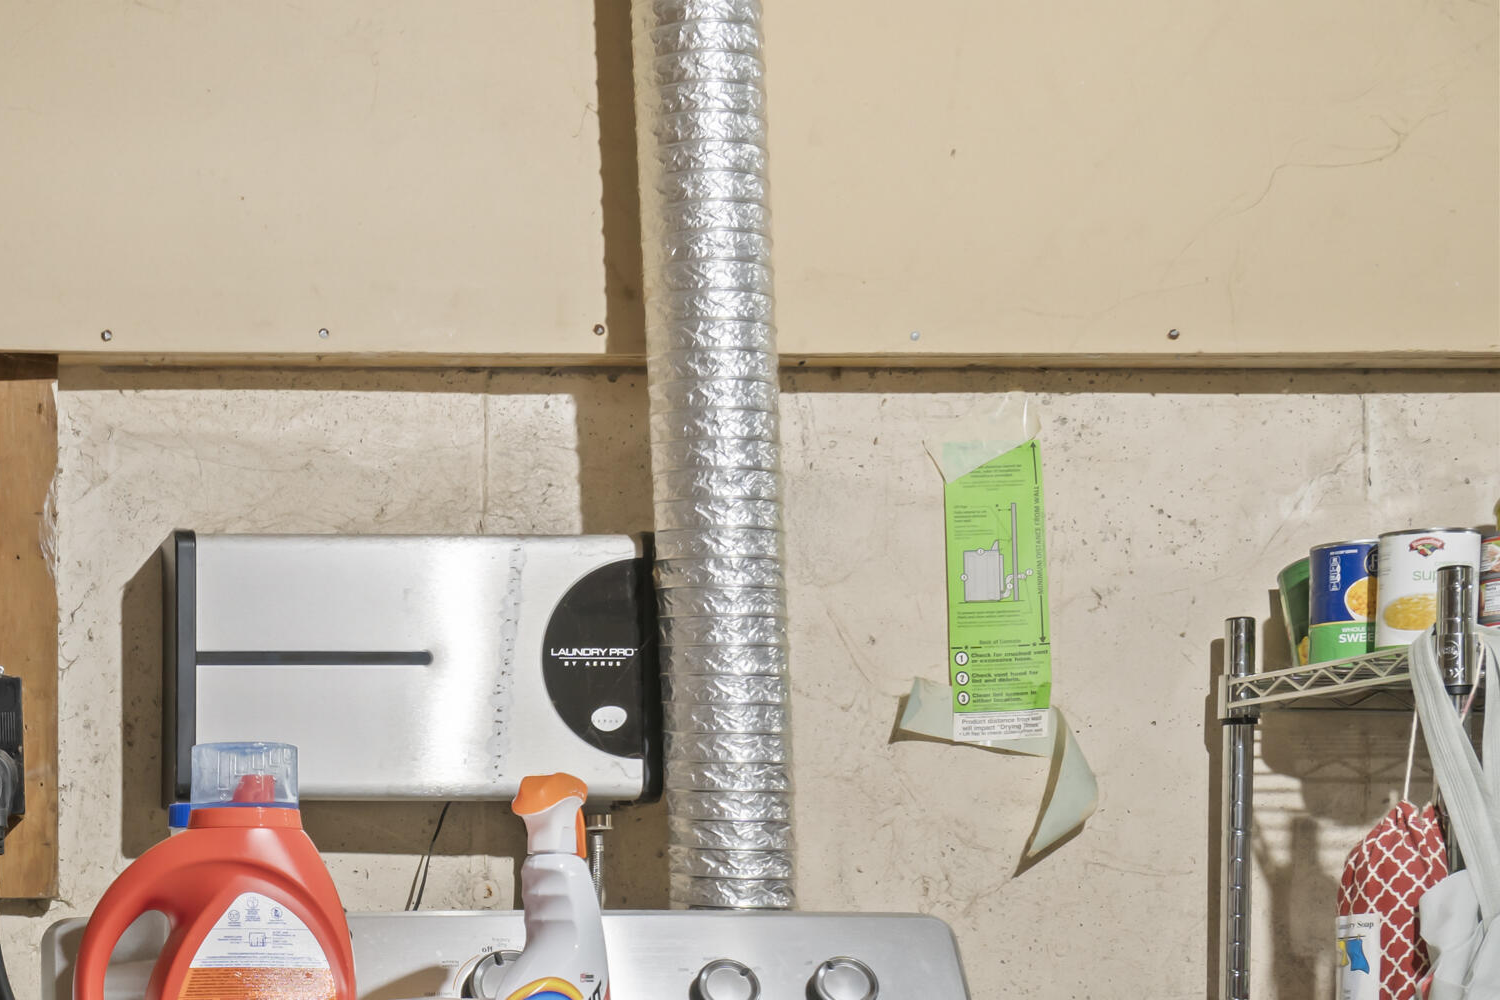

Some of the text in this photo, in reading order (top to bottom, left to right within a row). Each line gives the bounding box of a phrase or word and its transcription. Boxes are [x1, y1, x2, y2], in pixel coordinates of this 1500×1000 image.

[1033, 506, 1041, 526] FROM
[1034, 527, 1042, 559] DISTANCE
[1338, 633, 1375, 643] SWEE
[550, 647, 607, 657] LAUNDRY
[1356, 921, 1374, 929] Soap
[481, 945, 493, 953] off
